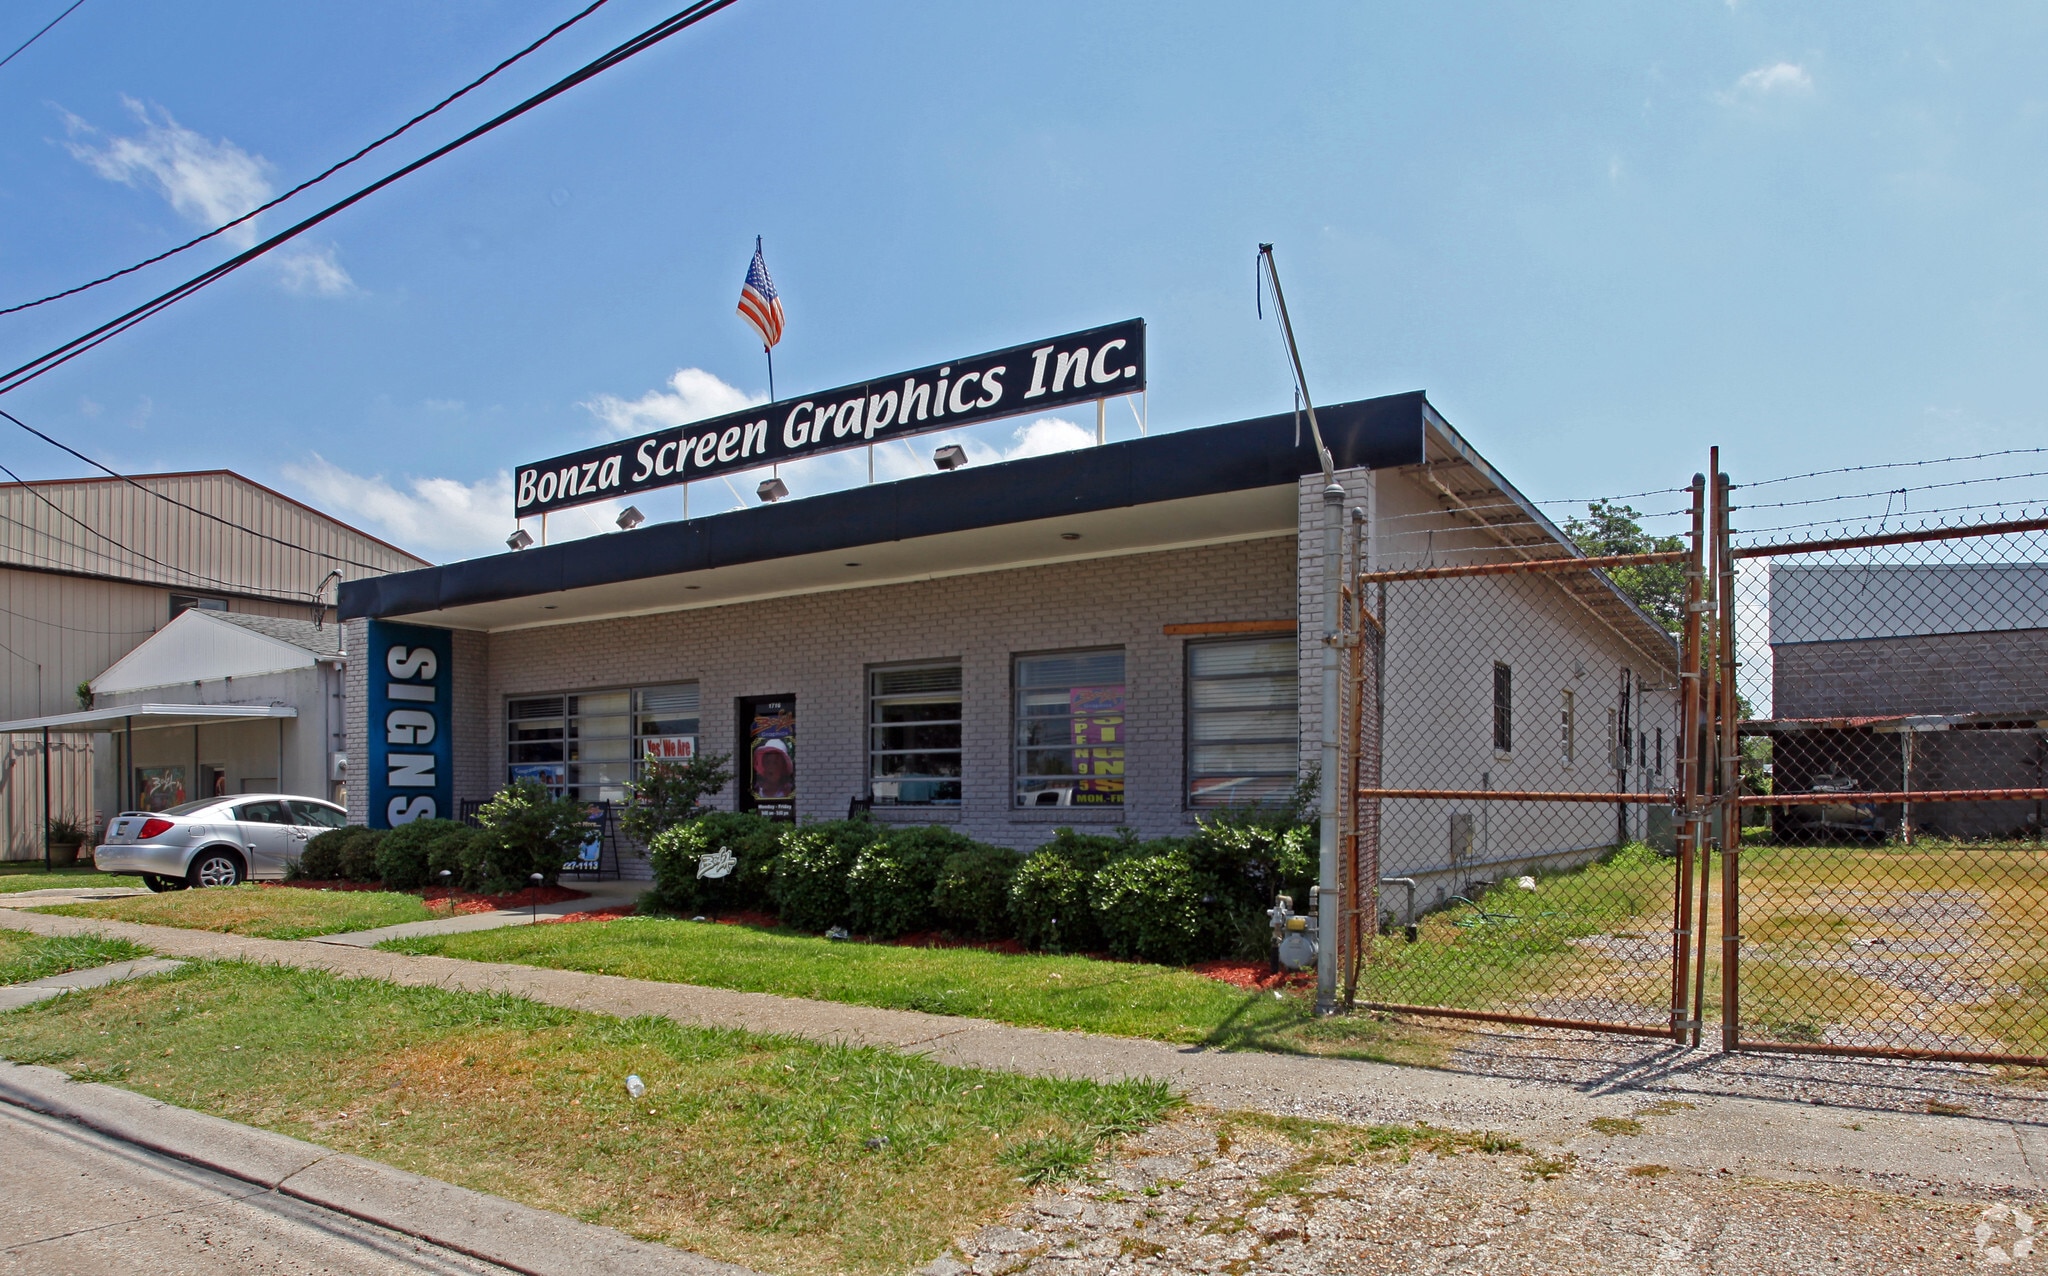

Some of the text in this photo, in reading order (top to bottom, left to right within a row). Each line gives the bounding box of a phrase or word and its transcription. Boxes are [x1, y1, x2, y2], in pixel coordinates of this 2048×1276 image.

[516, 338, 1137, 508] Bonza Screen Graphics Inc.
[387, 645, 438, 828] SIGNS
[663, 739, 676, 757] We
[677, 738, 691, 757] Are
[1074, 711, 1089, 758] OPEN
[1092, 710, 1124, 792] SIGNS
